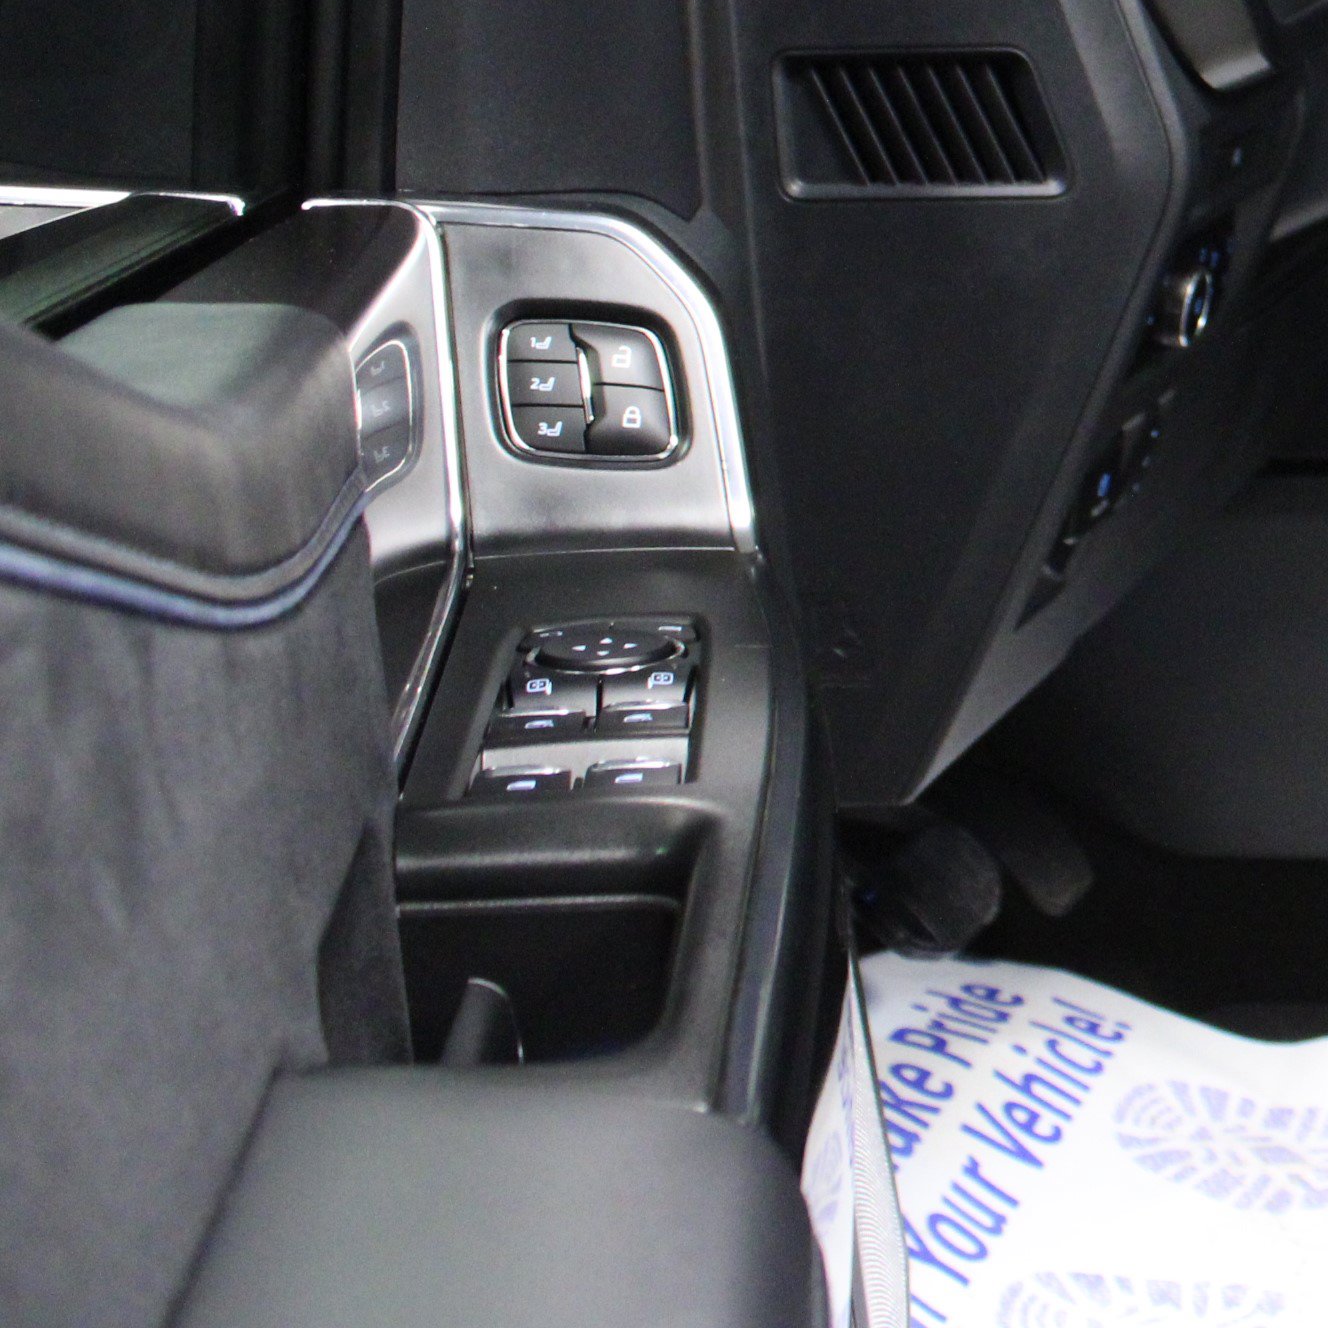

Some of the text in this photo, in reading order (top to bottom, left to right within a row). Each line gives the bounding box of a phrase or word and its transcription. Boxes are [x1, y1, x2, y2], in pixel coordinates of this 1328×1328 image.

[530, 377, 540, 390] 2
[538, 422, 548, 435] 3
[879, 983, 1024, 1172] ake Pride
[903, 997, 1132, 1285] Your Vehicle!
